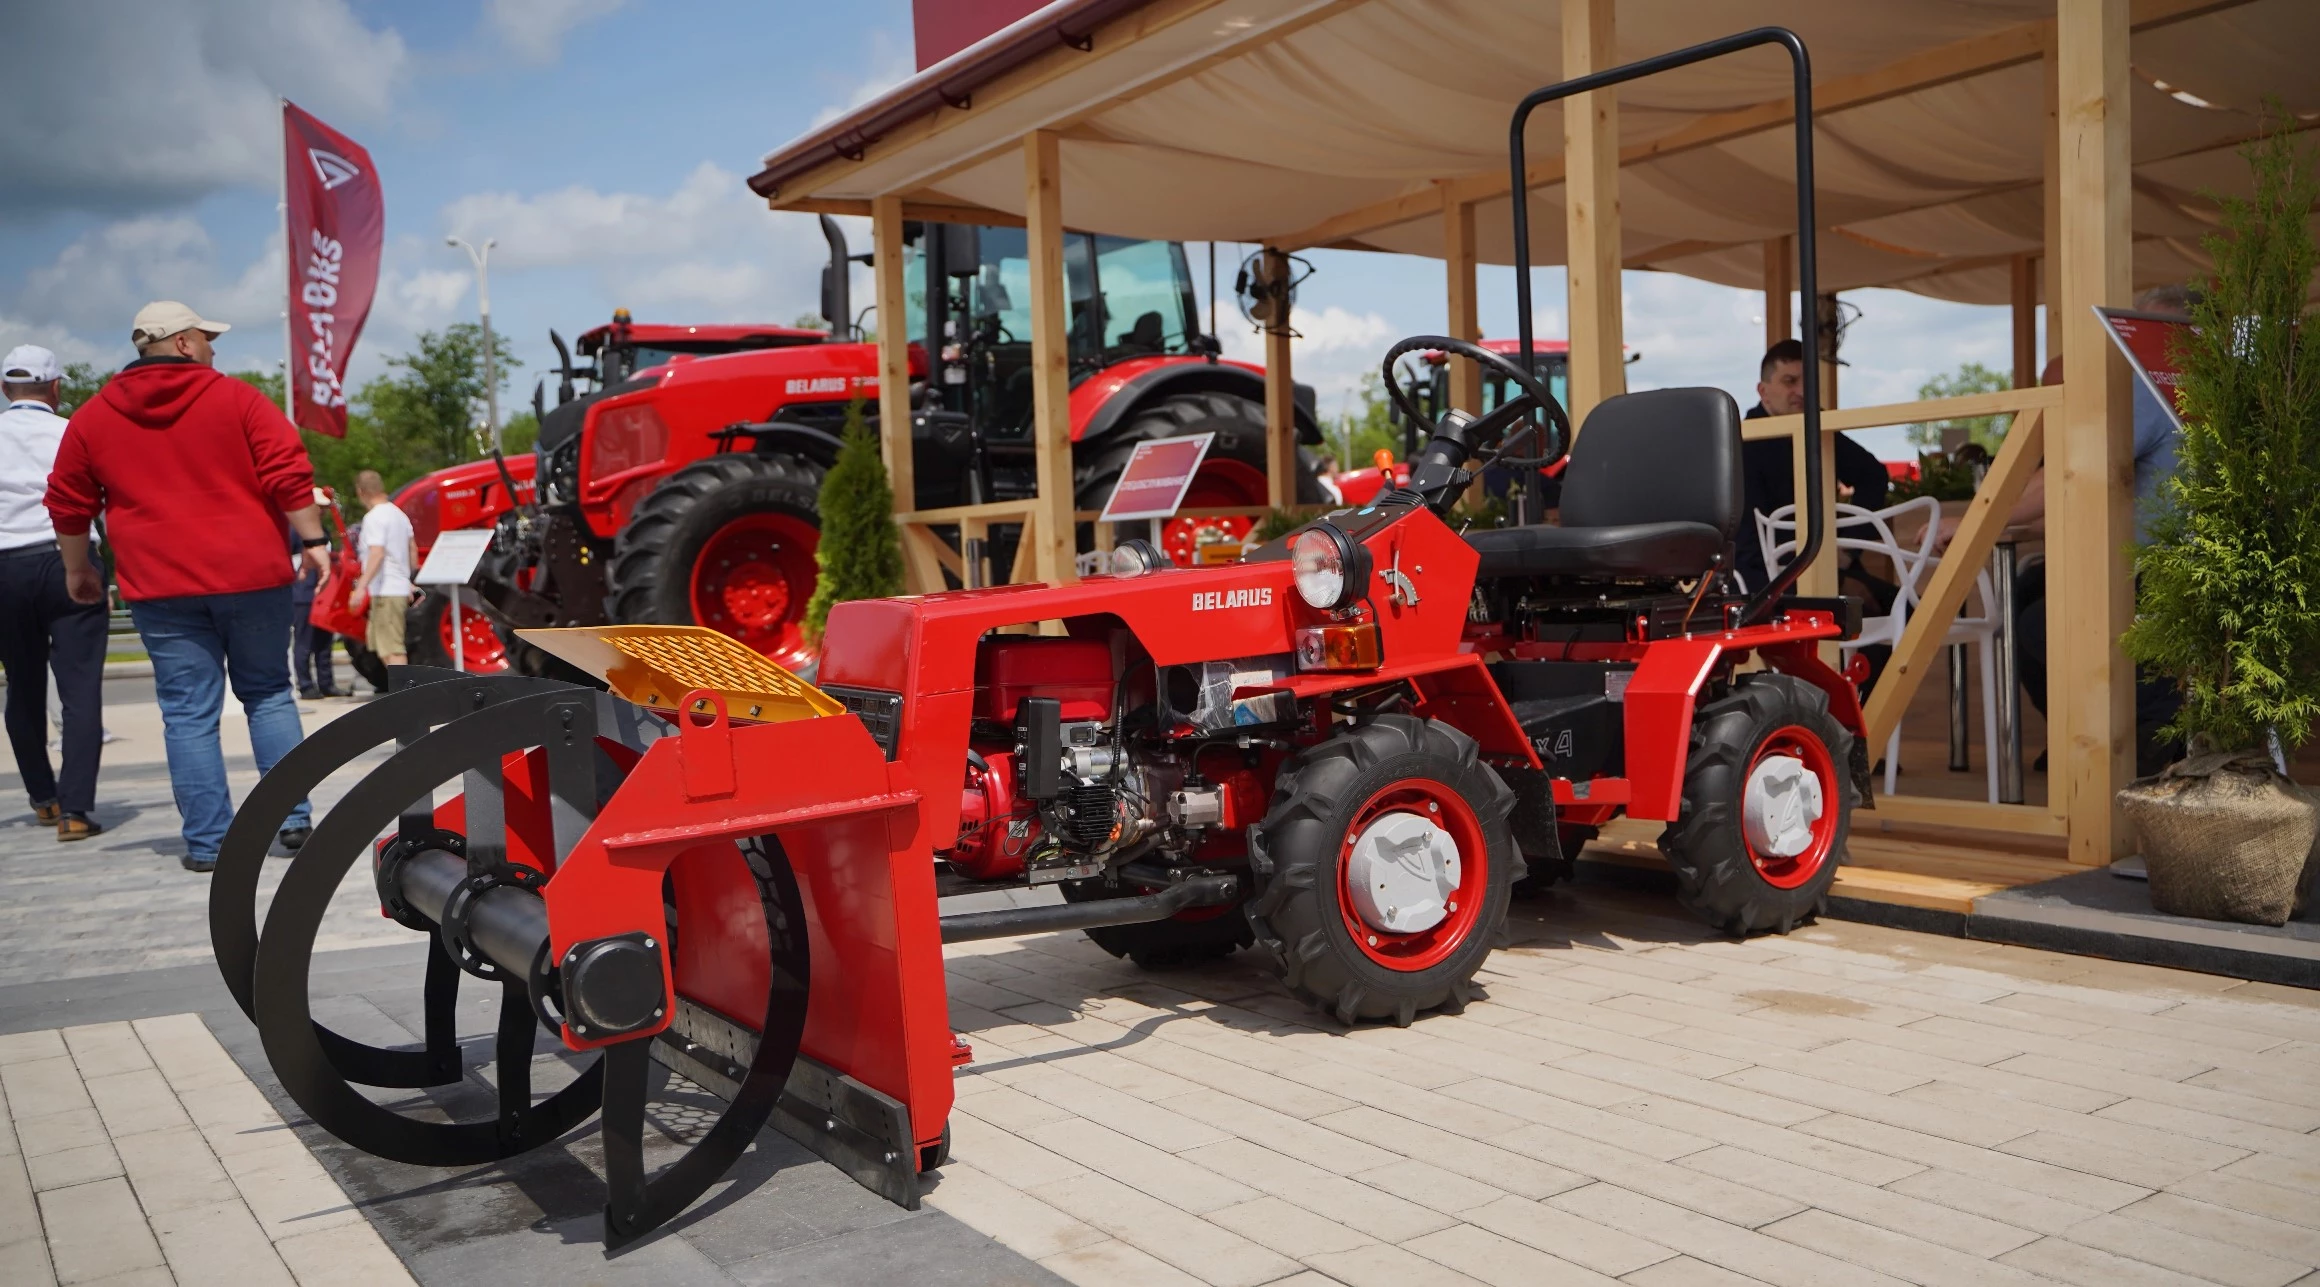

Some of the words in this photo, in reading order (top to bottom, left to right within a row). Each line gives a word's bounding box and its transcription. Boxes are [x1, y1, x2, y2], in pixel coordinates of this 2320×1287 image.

[786, 377, 846, 394] BELARUS
[1192, 588, 1272, 611] BELARUS
[1527, 730, 1573, 757] x4
